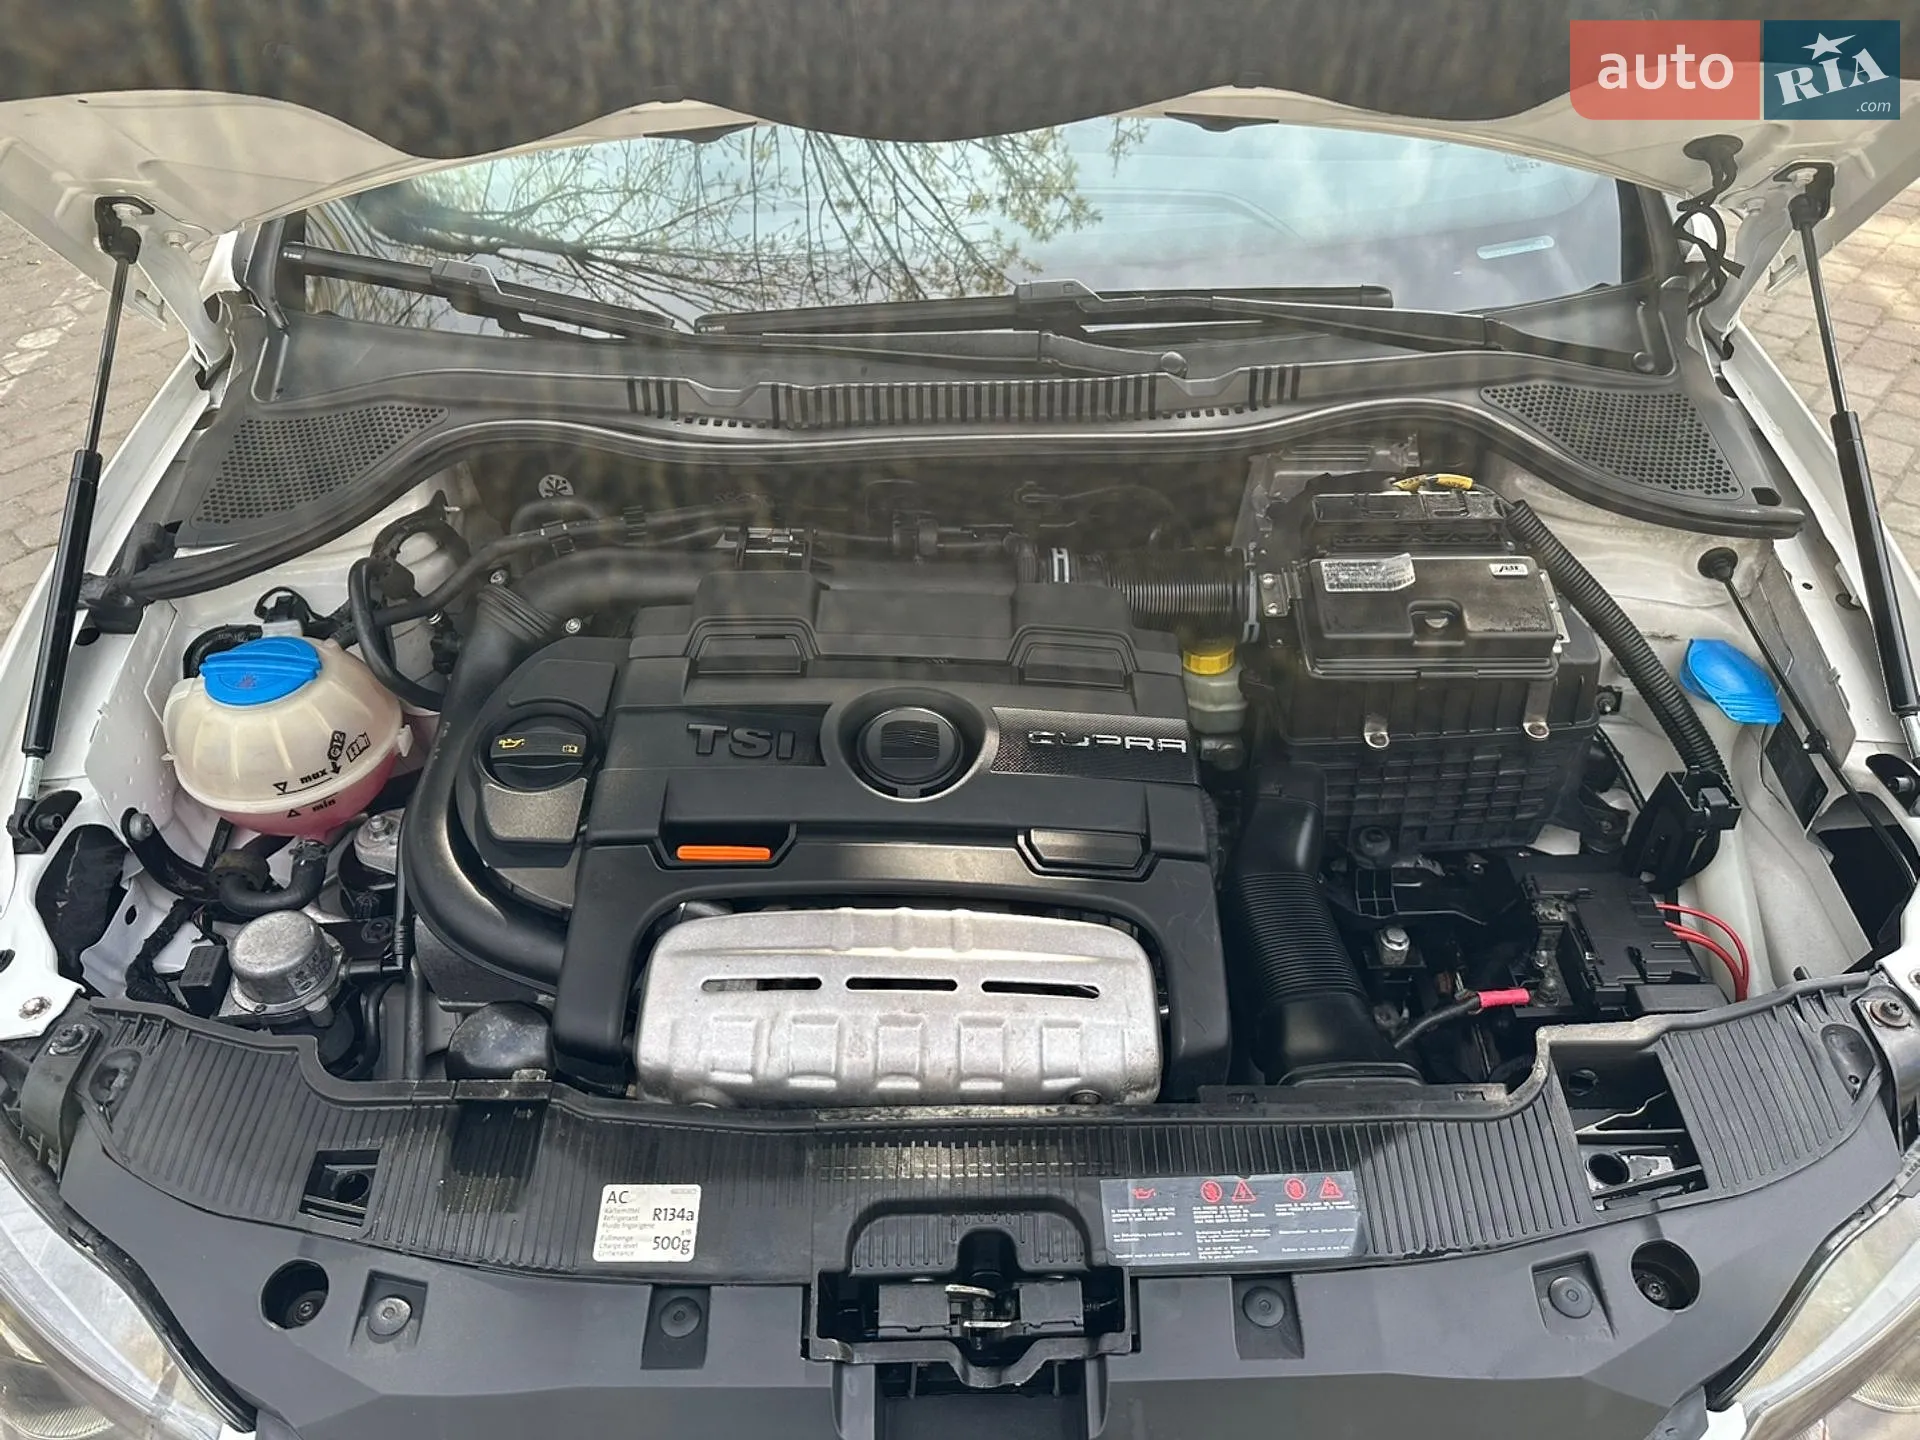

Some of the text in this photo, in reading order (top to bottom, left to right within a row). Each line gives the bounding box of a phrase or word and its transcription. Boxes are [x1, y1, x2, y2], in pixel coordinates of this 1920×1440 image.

[687, 723, 1187, 761] TSI CUPRA
[300, 769, 328, 784] max
[312, 798, 336, 812] min
[606, 1190, 629, 1204] AC
[652, 1207, 695, 1222] R134a
[652, 1236, 691, 1255] 500g
